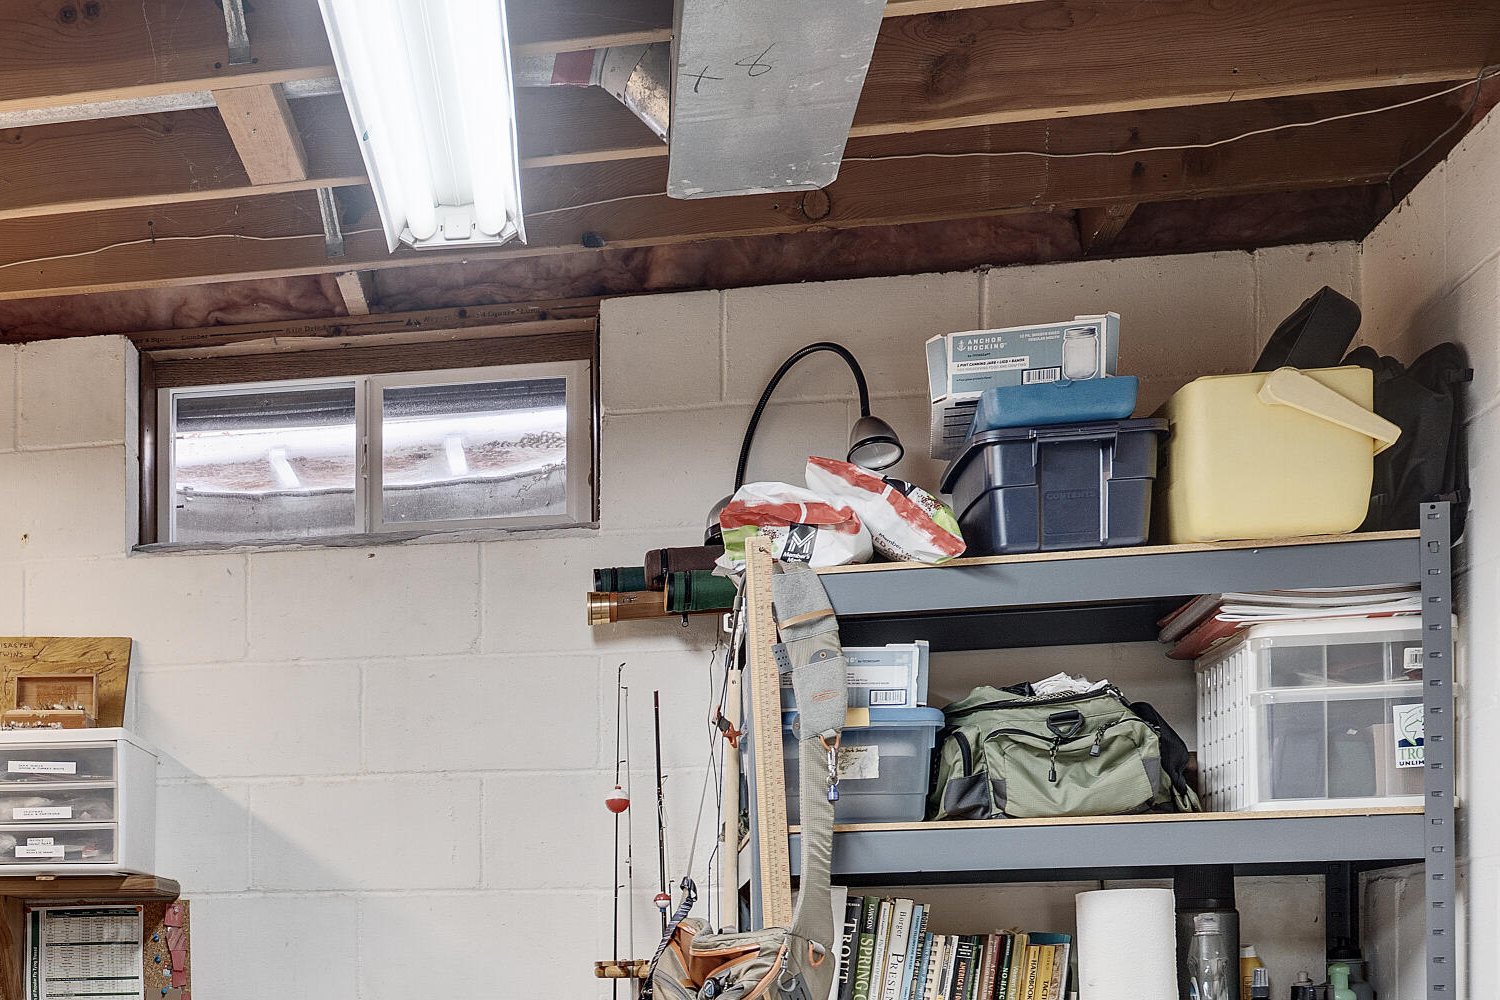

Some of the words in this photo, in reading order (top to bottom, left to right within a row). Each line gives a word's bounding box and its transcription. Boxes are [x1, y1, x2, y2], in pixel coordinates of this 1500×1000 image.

[967, 337, 1002, 345] ANCHOR
[967, 343, 1005, 351] HOCKING
[782, 551, 811, 560] Member's
[1398, 747, 1425, 761] TRO
[866, 904, 875, 929] LAWSON
[896, 911, 907, 938] Borger
[840, 917, 858, 984] TROUT
[854, 937, 874, 991] SPRING
[956, 961, 966, 991] AMERICA'S
[1001, 967, 1009, 979] NO
[1026, 959, 1037, 1000] HANDBOOK
